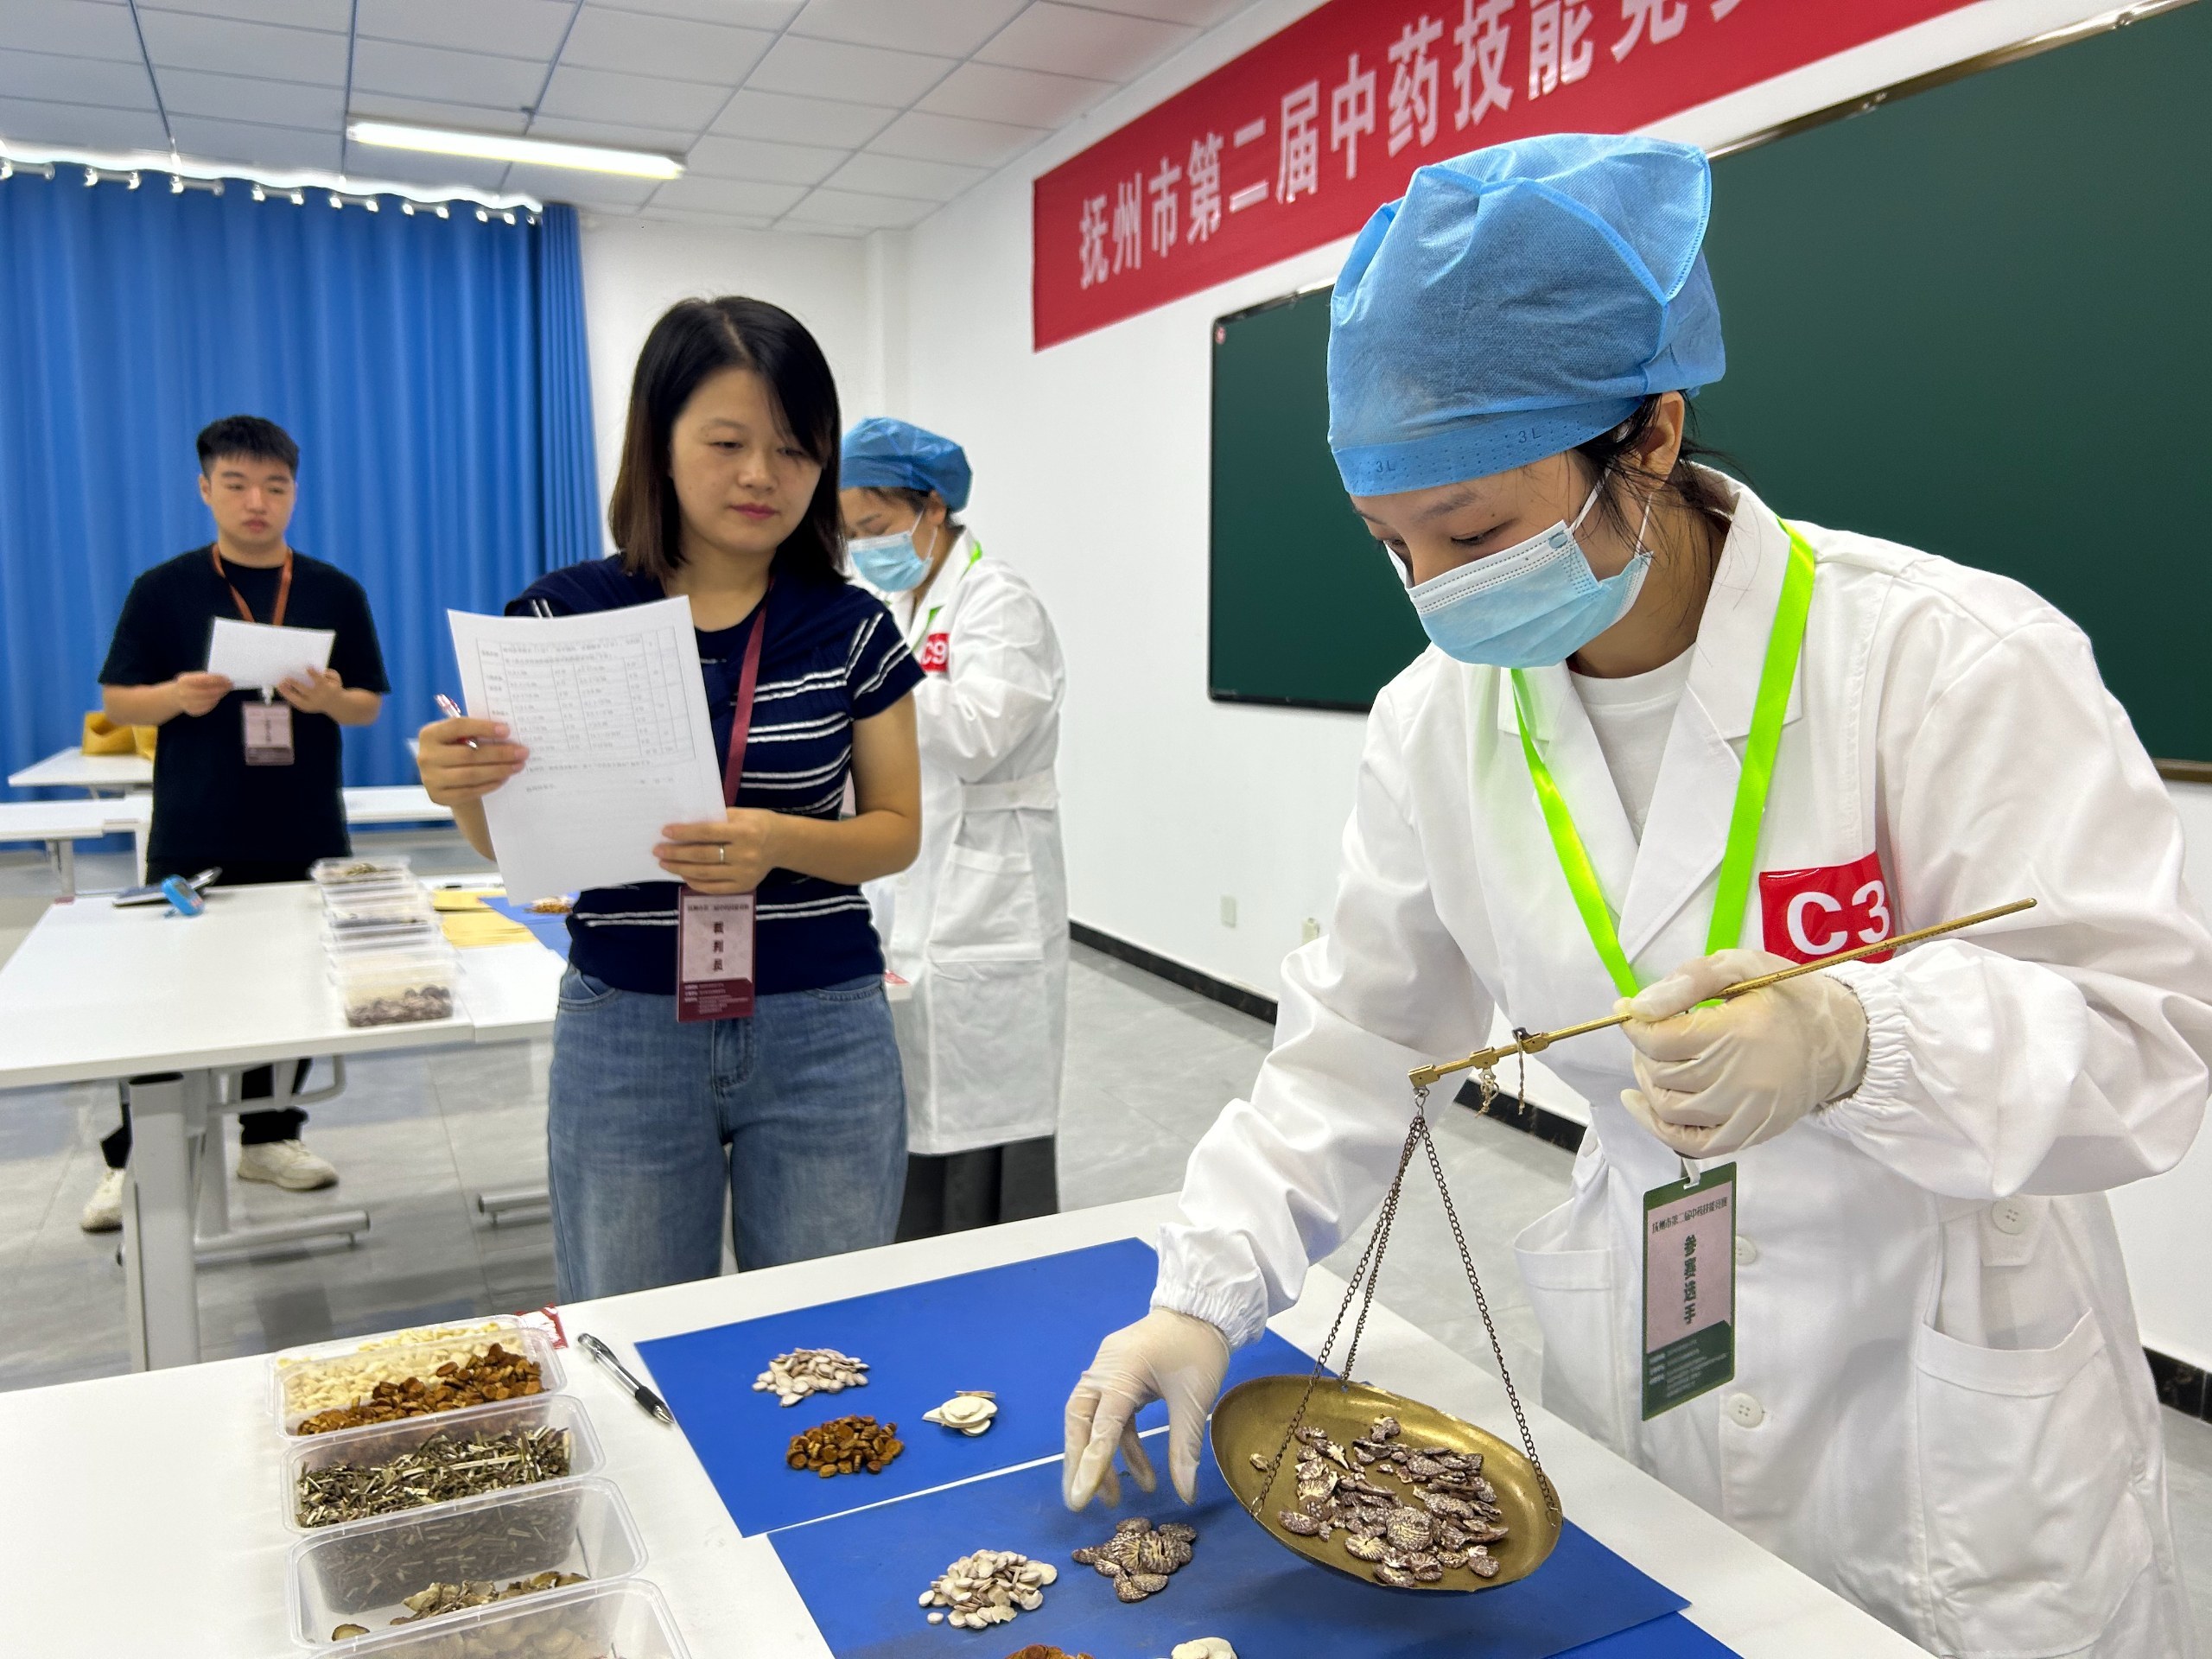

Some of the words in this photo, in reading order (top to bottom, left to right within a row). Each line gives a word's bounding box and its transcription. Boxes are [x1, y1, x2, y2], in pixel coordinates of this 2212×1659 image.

[1079, 0, 1743, 290] 抚州市第二届中药技能
[1517, 427, 1541, 444] 3L
[1375, 460, 1396, 474] 3L
[921, 640, 947, 665] C9
[1786, 879, 1891, 956] C3
[1683, 1234, 1697, 1325] 参赛选手
